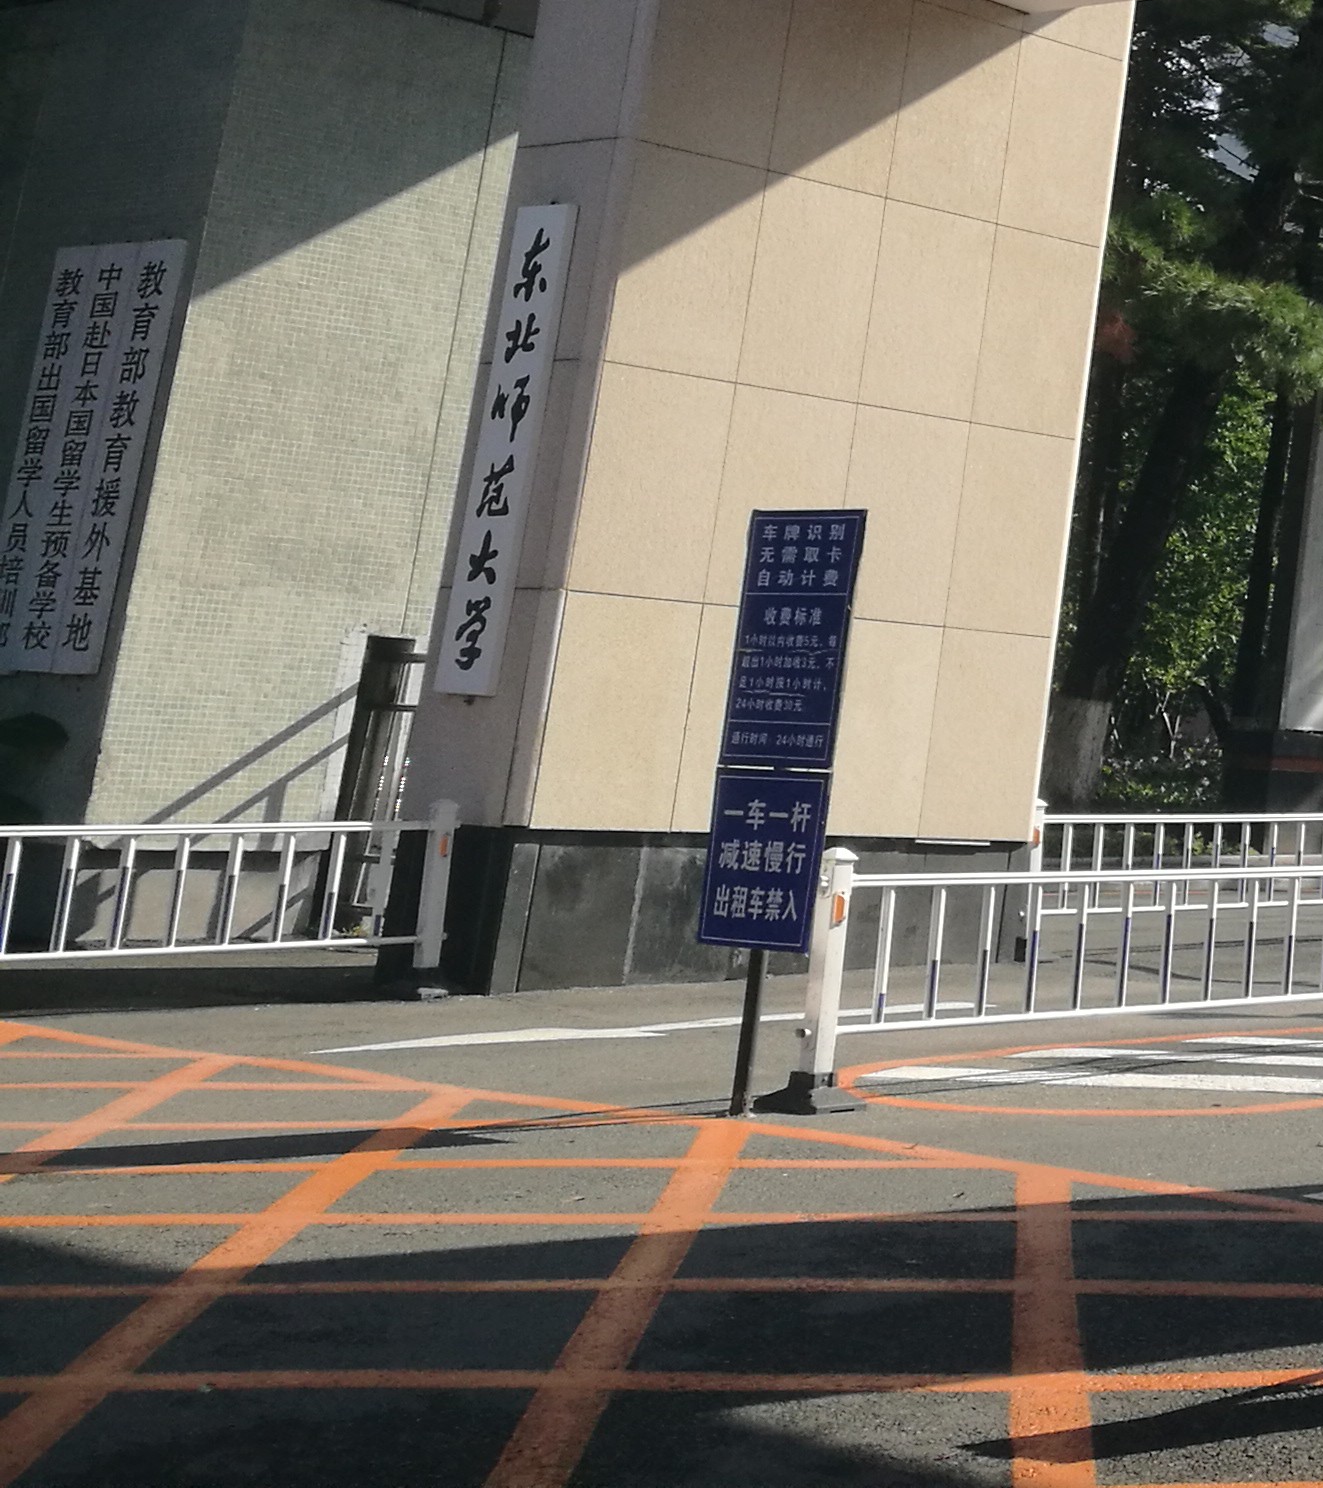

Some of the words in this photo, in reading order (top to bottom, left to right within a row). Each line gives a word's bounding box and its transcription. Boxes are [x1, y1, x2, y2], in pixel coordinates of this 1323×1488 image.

[22, 262, 123, 650] 中国赴日本国留学生预备学校
[62, 260, 168, 652] 教育部教育援外基地
[455, 227, 551, 671] 东北师范大学
[762, 523, 846, 541] 车牌识别
[760, 545, 842, 563] 无需取卡
[757, 568, 839, 587] 自动计费
[764, 607, 823, 626] 收费标准
[723, 798, 812, 833] 一车一杆
[718, 839, 806, 875] 减速慢行
[713, 883, 799, 923] 出租车禁入
